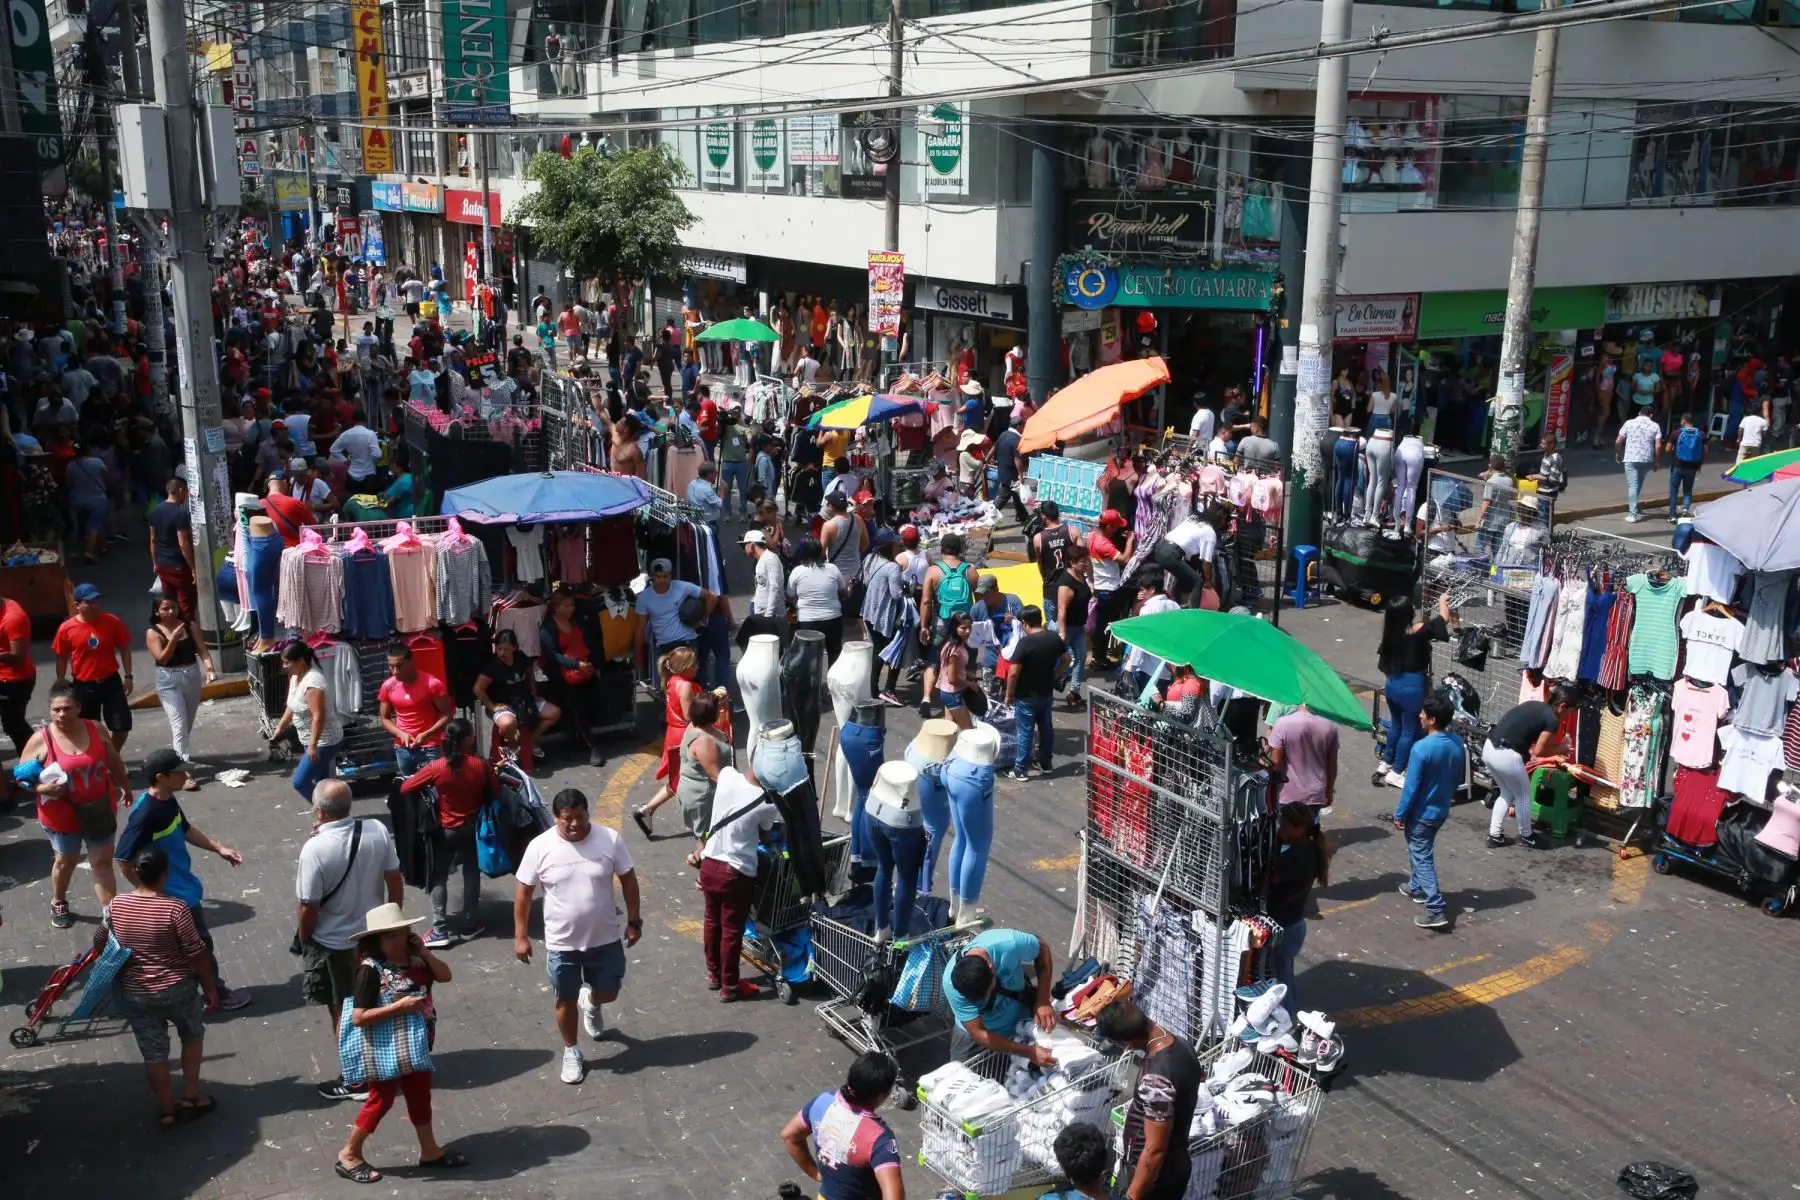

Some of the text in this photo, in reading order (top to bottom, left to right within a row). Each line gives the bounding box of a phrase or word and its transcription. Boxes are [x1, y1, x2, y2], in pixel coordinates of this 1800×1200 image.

[359, 12, 386, 149] CHIFA
[927, 136, 961, 147] GAMARRA
[1124, 274, 1268, 299] CENTRO GAMARRA
[936, 288, 988, 315] Gissett
[1348, 303, 1398, 322] En Curvas
[1340, 326, 1357, 334] FAJAS
[465, 353, 495, 367] POLOS
[1053, 548, 1065, 570] 1
[1696, 630, 1727, 643] TOKYO
